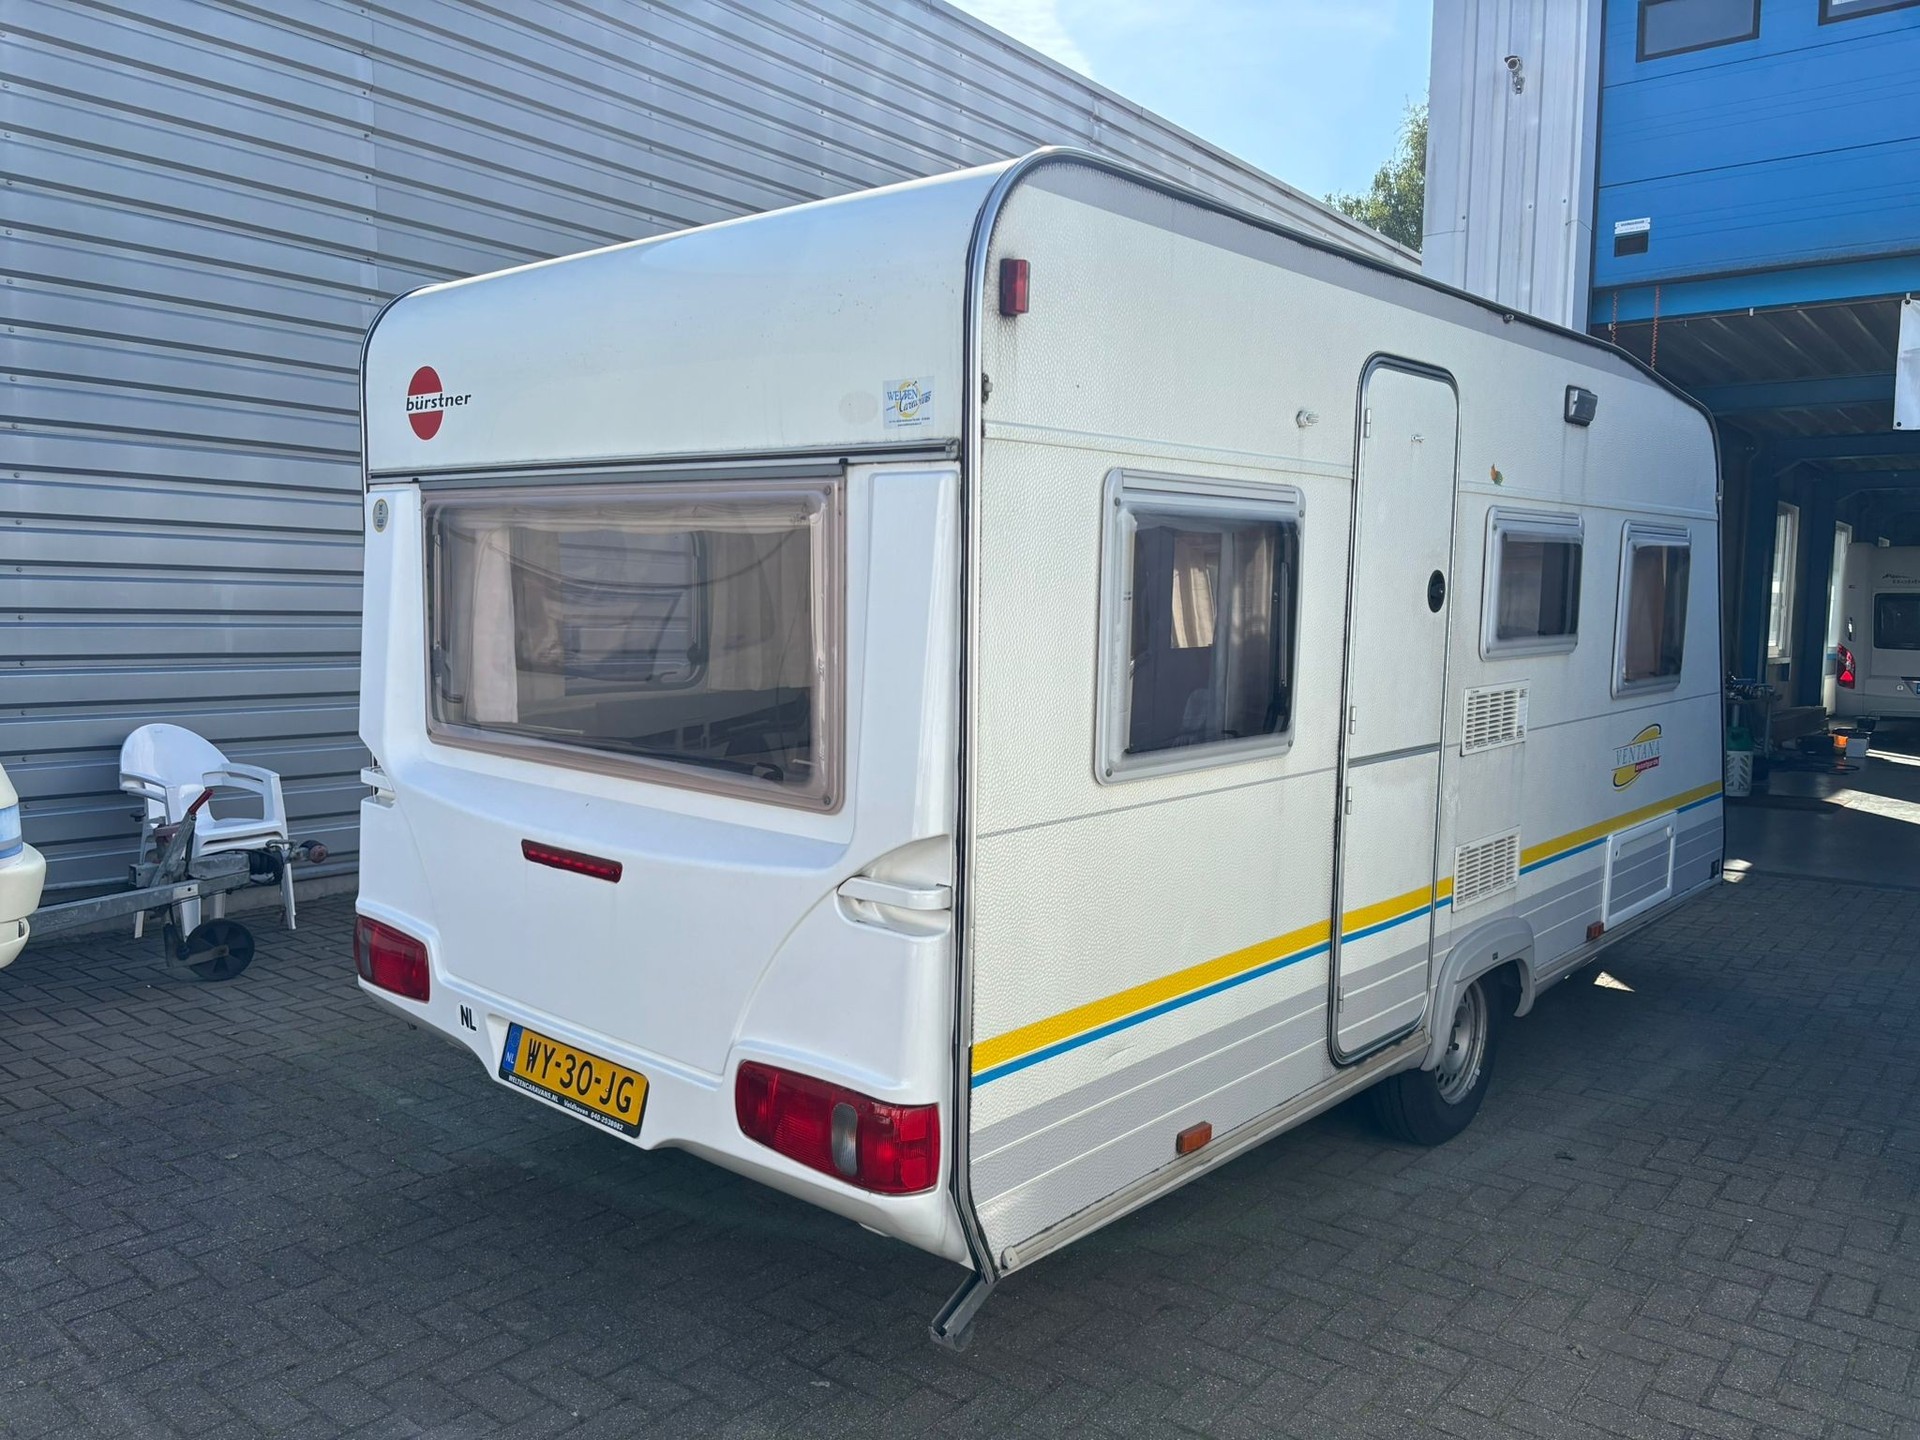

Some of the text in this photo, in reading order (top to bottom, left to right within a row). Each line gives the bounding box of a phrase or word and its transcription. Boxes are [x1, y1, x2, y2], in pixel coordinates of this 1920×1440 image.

[406, 393, 472, 411] bürstner
[1616, 740, 1660, 766] VENTANA
[460, 1004, 477, 1031] NL
[505, 1051, 514, 1064] NL
[525, 1038, 635, 1113] WY-30-JG
[563, 1100, 589, 1116] Veldhoven
